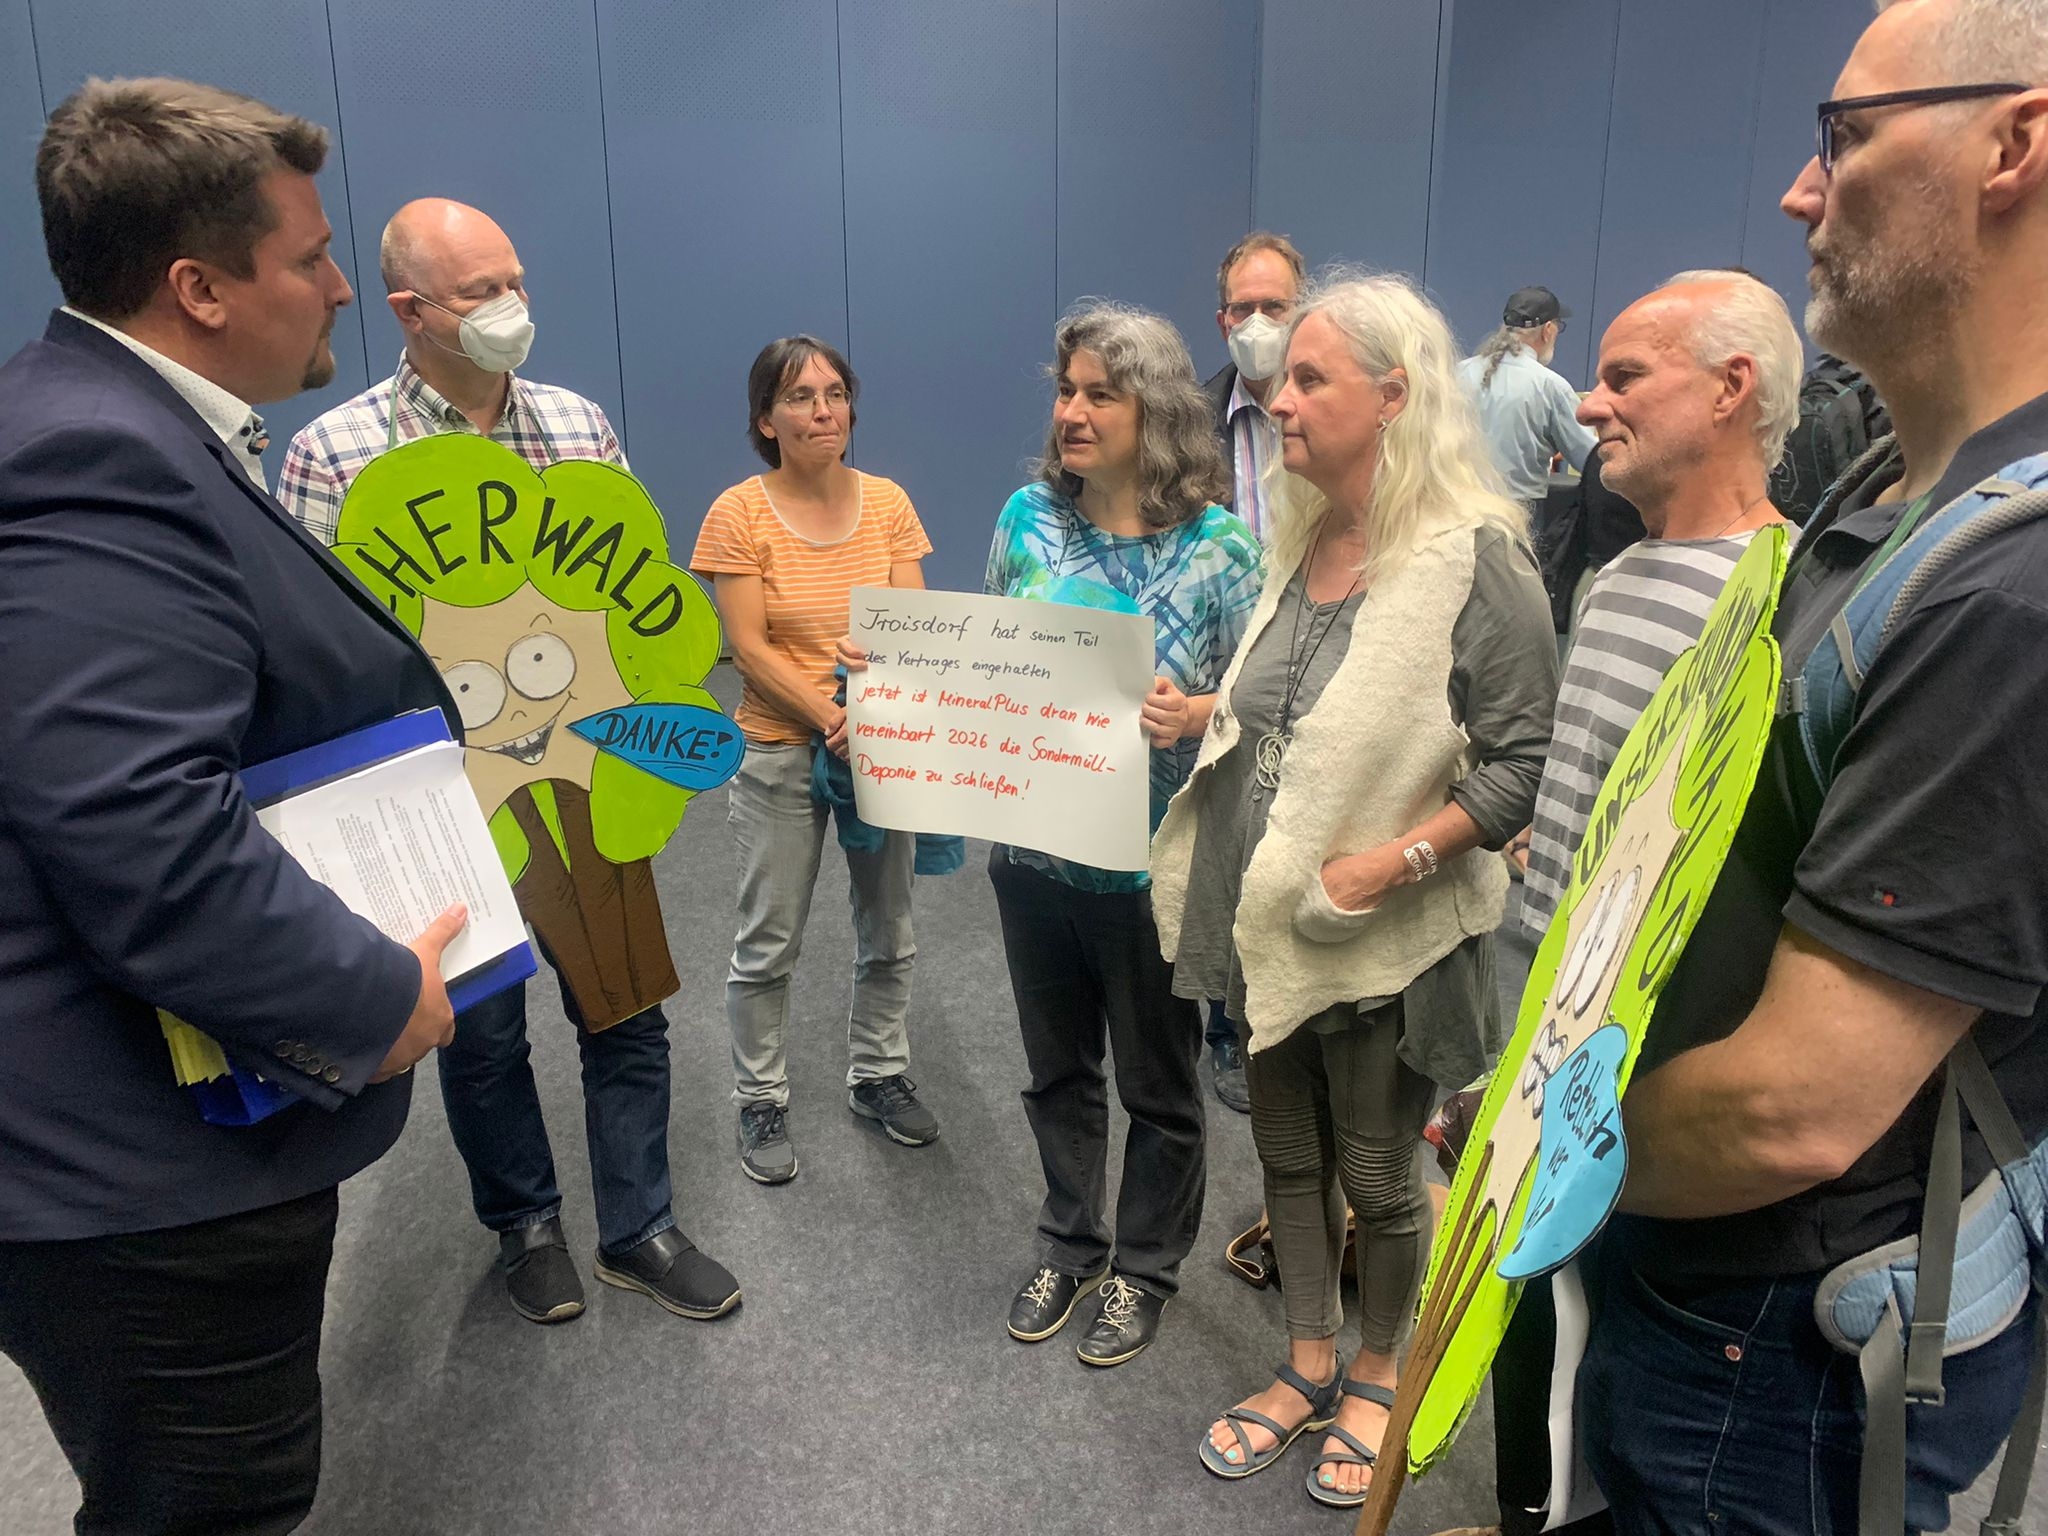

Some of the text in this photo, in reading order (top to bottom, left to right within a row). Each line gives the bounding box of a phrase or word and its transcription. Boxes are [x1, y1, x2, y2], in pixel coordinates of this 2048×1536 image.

[356, 480, 683, 638] HERWALD
[859, 607, 1099, 647] Troisdorf hat seinen Teil
[864, 650, 1051, 681] des Vertrages eingehalten
[856, 680, 902, 704] jetzt
[911, 689, 928, 703] ist
[937, 690, 1029, 716] MineralPlus
[1040, 701, 1078, 722] dran
[593, 712, 734, 761] DANKE!
[856, 721, 1117, 773] vereinbart 2026 die Sondermüll-
[856, 752, 1031, 801] Deponie zu schließen!
[1580, 684, 1680, 886] UNSER
[1638, 657, 1750, 992] WALD
